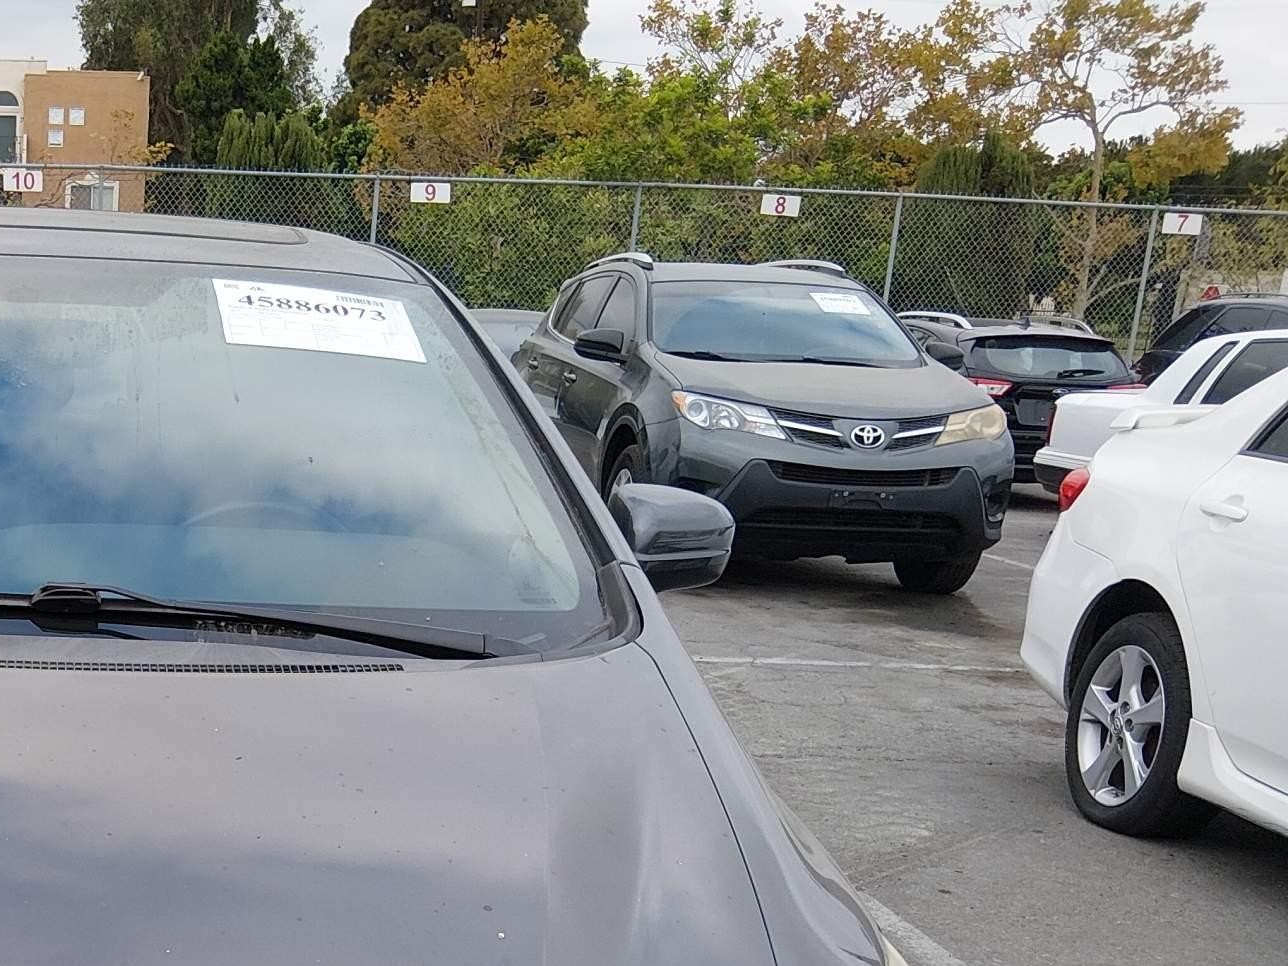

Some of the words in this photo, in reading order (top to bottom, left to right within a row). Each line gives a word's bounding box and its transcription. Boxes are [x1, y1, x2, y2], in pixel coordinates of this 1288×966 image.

[12, 171, 35, 190] 10
[424, 184, 437, 201] 9
[775, 196, 786, 214] 8
[1177, 214, 1190, 233] 7
[238, 295, 387, 321] 45886073
